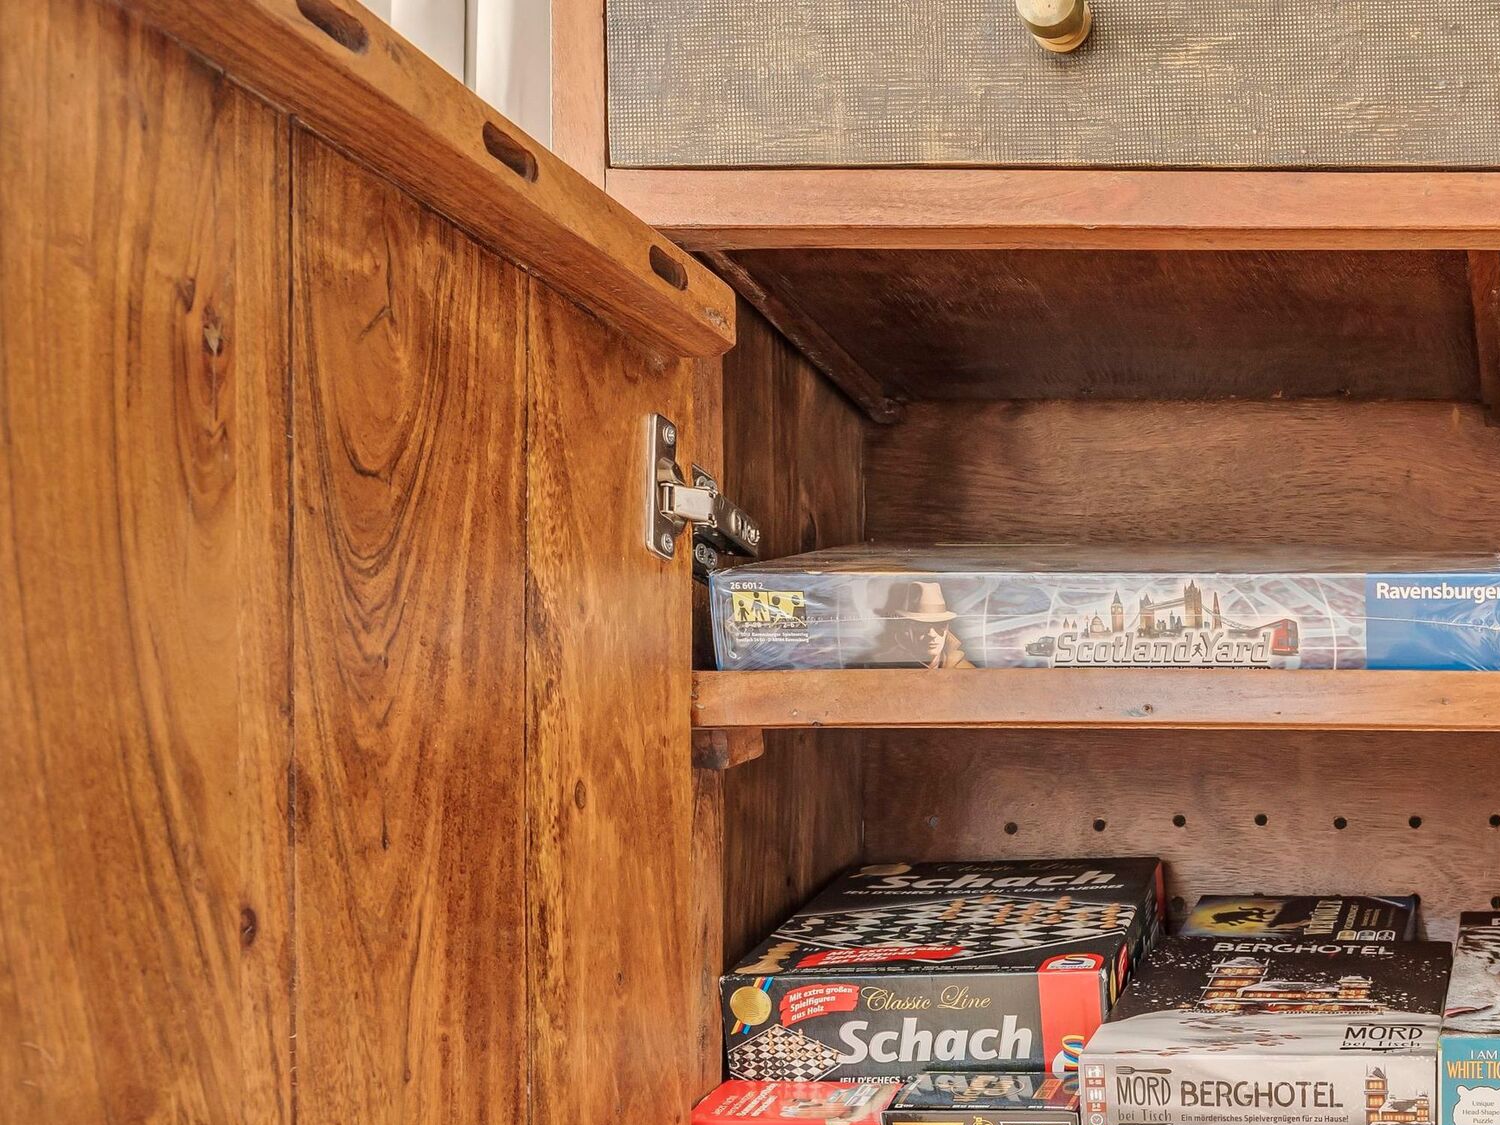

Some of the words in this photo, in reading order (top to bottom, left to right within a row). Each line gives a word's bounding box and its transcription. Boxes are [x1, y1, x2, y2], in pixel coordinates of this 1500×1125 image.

[730, 582, 741, 590] 26
[1055, 631, 1195, 663] Scotland
[1200, 631, 1272, 663] Yard
[867, 870, 1117, 889] Schach
[1212, 942, 1395, 956] BERGHOTEL
[788, 992, 804, 1002] Mit
[804, 988, 825, 999] extra
[825, 986, 853, 997] großen
[860, 986, 932, 1011] Classic
[937, 984, 992, 1010] Line
[790, 994, 836, 1012] Spielfiguren
[791, 1011, 806, 1021] aus
[806, 1004, 825, 1017] Holz
[838, 1015, 1033, 1065] Schach
[1344, 1026, 1424, 1041] MORD
[1475, 1050, 1498, 1060] AM
[1447, 1061, 1484, 1079] WHITE
[1116, 1076, 1172, 1106] MORD
[1180, 1080, 1344, 1108] BERGHOTEL
[1118, 1109, 1136, 1121] bei
[1141, 1108, 1172, 1122] Tisch
[1181, 1114, 1193, 1122] Ein
[1194, 1114, 1243, 1122] mörderisches
[1244, 1114, 1301, 1125] Spielvergnügen
[1302, 1114, 1313, 1122] für
[1324, 1114, 1349, 1123] Hause!
